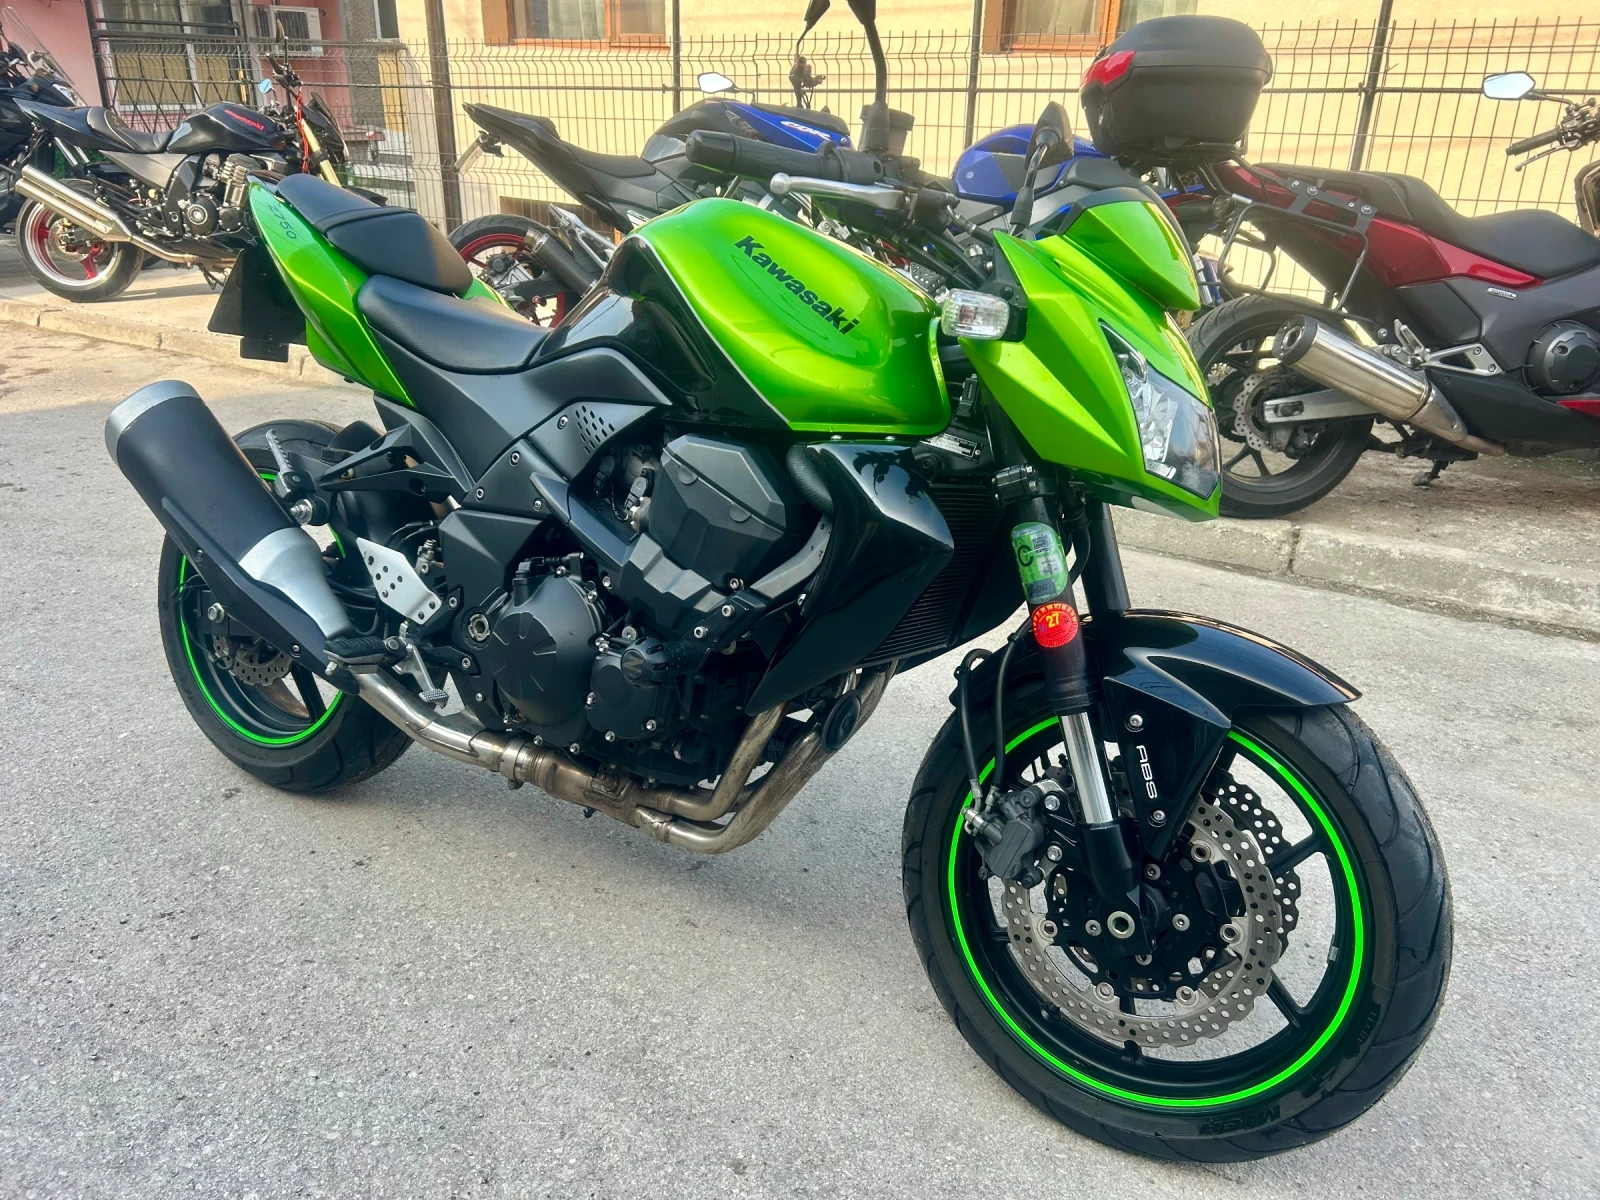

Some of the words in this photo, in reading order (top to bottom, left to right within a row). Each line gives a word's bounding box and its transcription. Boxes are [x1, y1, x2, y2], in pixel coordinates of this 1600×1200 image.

[267, 203, 297, 239] Z750
[734, 235, 860, 335] Kawasaki
[1018, 545, 1034, 567] C
[1046, 612, 1061, 628] 27
[1136, 745, 1158, 799] ABS
